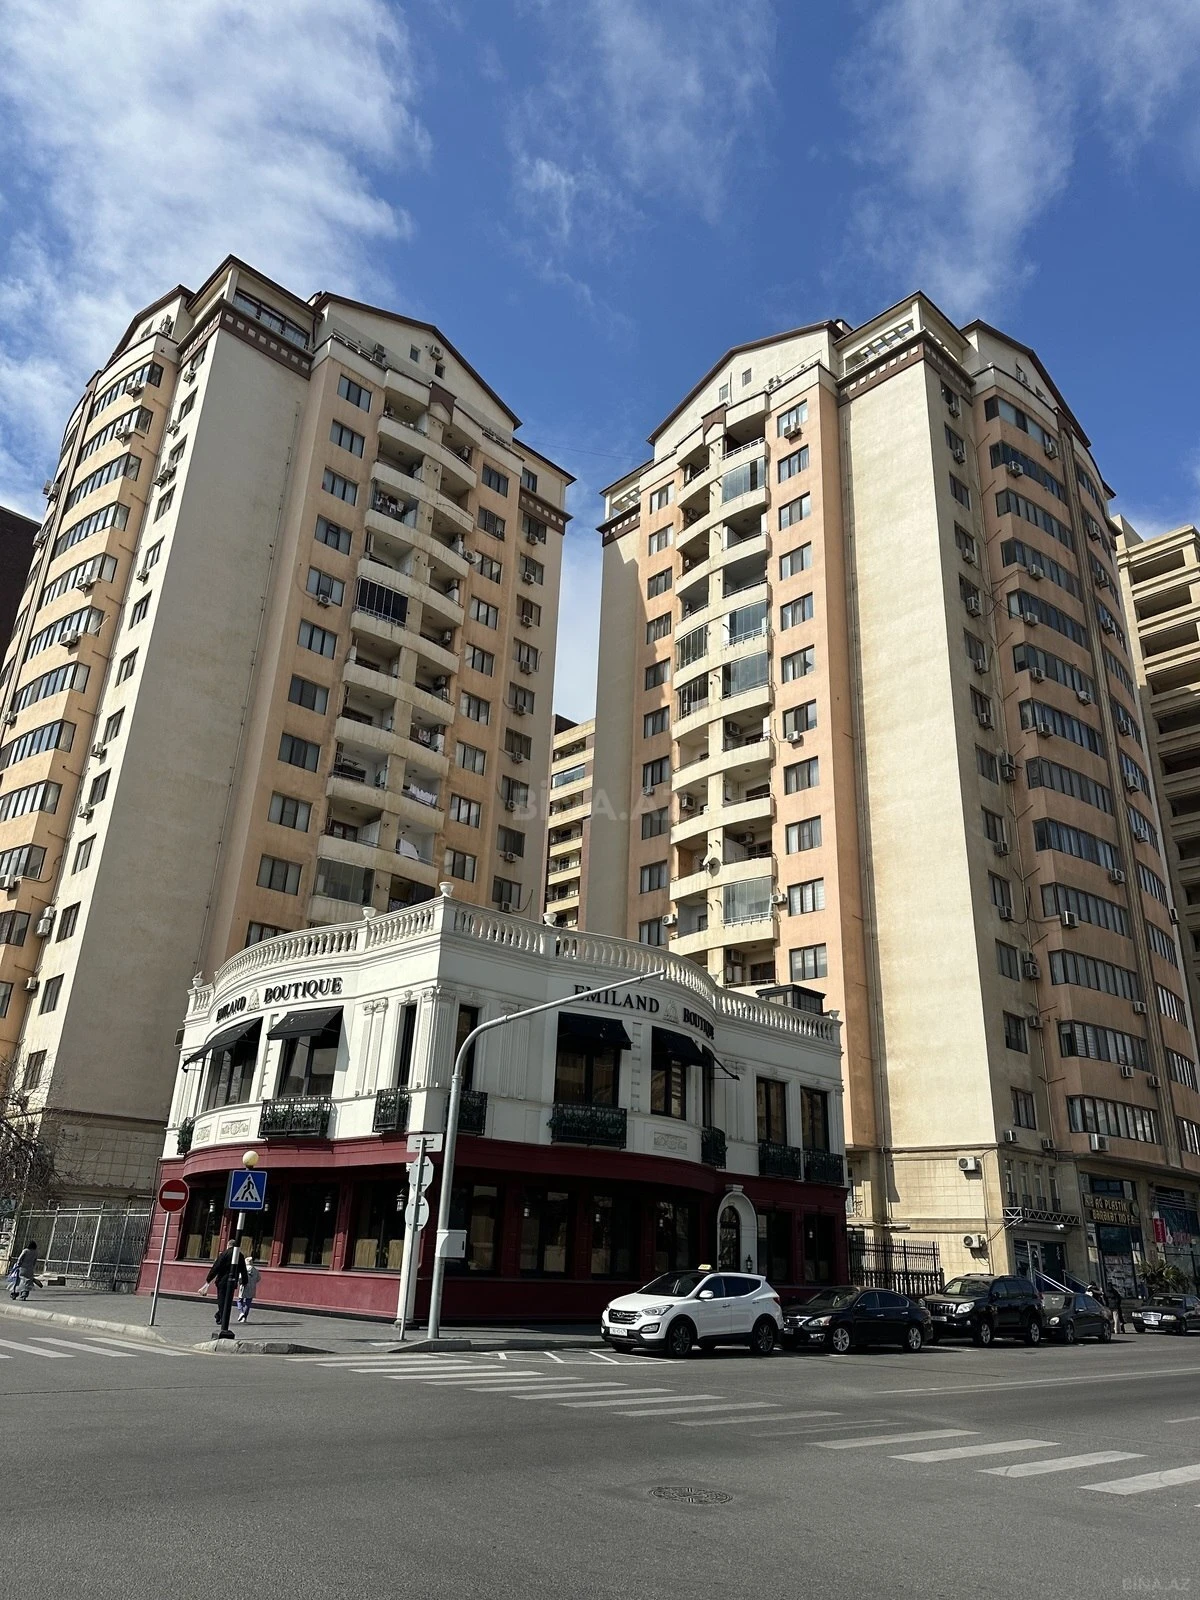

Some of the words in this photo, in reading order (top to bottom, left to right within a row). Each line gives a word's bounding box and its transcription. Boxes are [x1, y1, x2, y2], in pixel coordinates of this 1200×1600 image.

[263, 977, 343, 1004] BOUTIQUE
[574, 985, 660, 1013] EMILAND
[683, 1007, 715, 1040] BOUTIQUE
